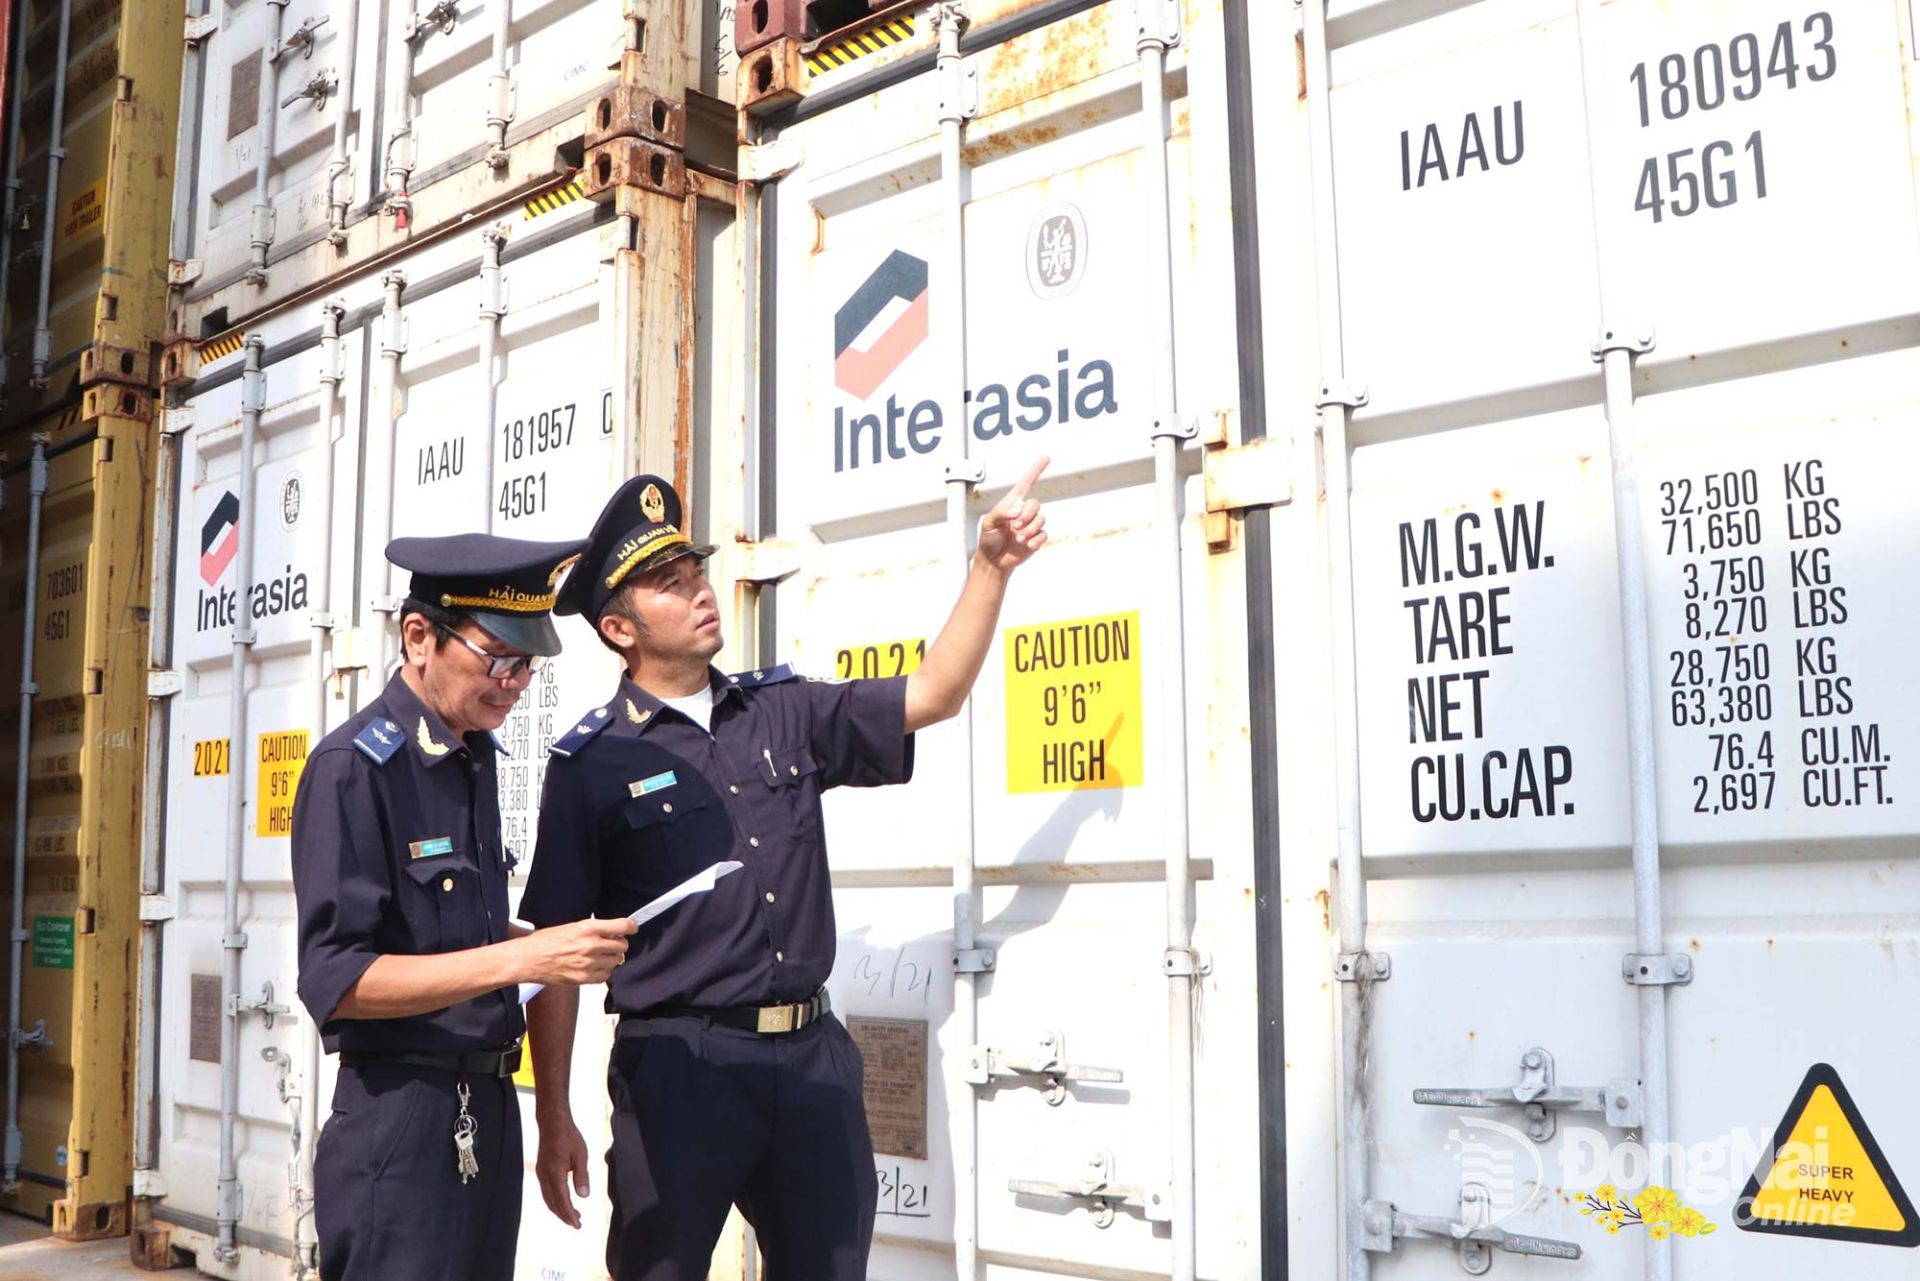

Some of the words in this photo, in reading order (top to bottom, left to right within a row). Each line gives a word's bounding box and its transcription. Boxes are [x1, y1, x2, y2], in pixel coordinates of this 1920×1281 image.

[1400, 100, 1525, 192] IAAU
[1629, 11, 1837, 128] 180943
[1633, 130, 1767, 224] 45G1
[834, 347, 1118, 474] Inteasia
[418, 436, 464, 486] IAAU
[503, 403, 576, 463] 181957
[499, 471, 546, 521] 45G1
[1398, 500, 1555, 588] M.G.W.
[1660, 469, 1759, 517] 32,500
[1783, 459, 1825, 500] KG
[1661, 508, 1762, 556] 71,650
[1787, 497, 1842, 541] LBS
[47, 562, 83, 600] 703601
[1403, 586, 1514, 665] TARE
[1683, 555, 1765, 602] 3,750
[1790, 547, 1832, 588] KG
[44, 609, 70, 641] 45G1
[1685, 595, 1767, 640] 8,270
[1793, 586, 1848, 629] LBS
[1014, 619, 1130, 673] CAUTION
[539, 685, 559, 709] LBS
[540, 662, 554, 685] KG
[1407, 669, 1490, 744] NET
[1670, 643, 1770, 688] 28,750
[1796, 636, 1838, 677] KG
[538, 713, 553, 736] KG
[1671, 683, 1772, 728] 63,380
[1798, 676, 1854, 718] LBS
[194, 738, 231, 776] 2021
[261, 734, 307, 763] CAUTION
[1042, 738, 1105, 784] HIGH
[1410, 745, 1575, 823] CU.CAP.
[1708, 730, 1774, 772] 76.4
[1801, 723, 1891, 766] CU.M.
[496, 766, 528, 789] 8,750
[500, 789, 528, 812] 3,380
[1693, 771, 1776, 815] 2,697
[1803, 765, 1894, 808] CU.FT.
[506, 816, 527, 838] 76.4
[1798, 1163, 1854, 1181] SUPER
[1799, 1187, 1855, 1204] HEAVY
